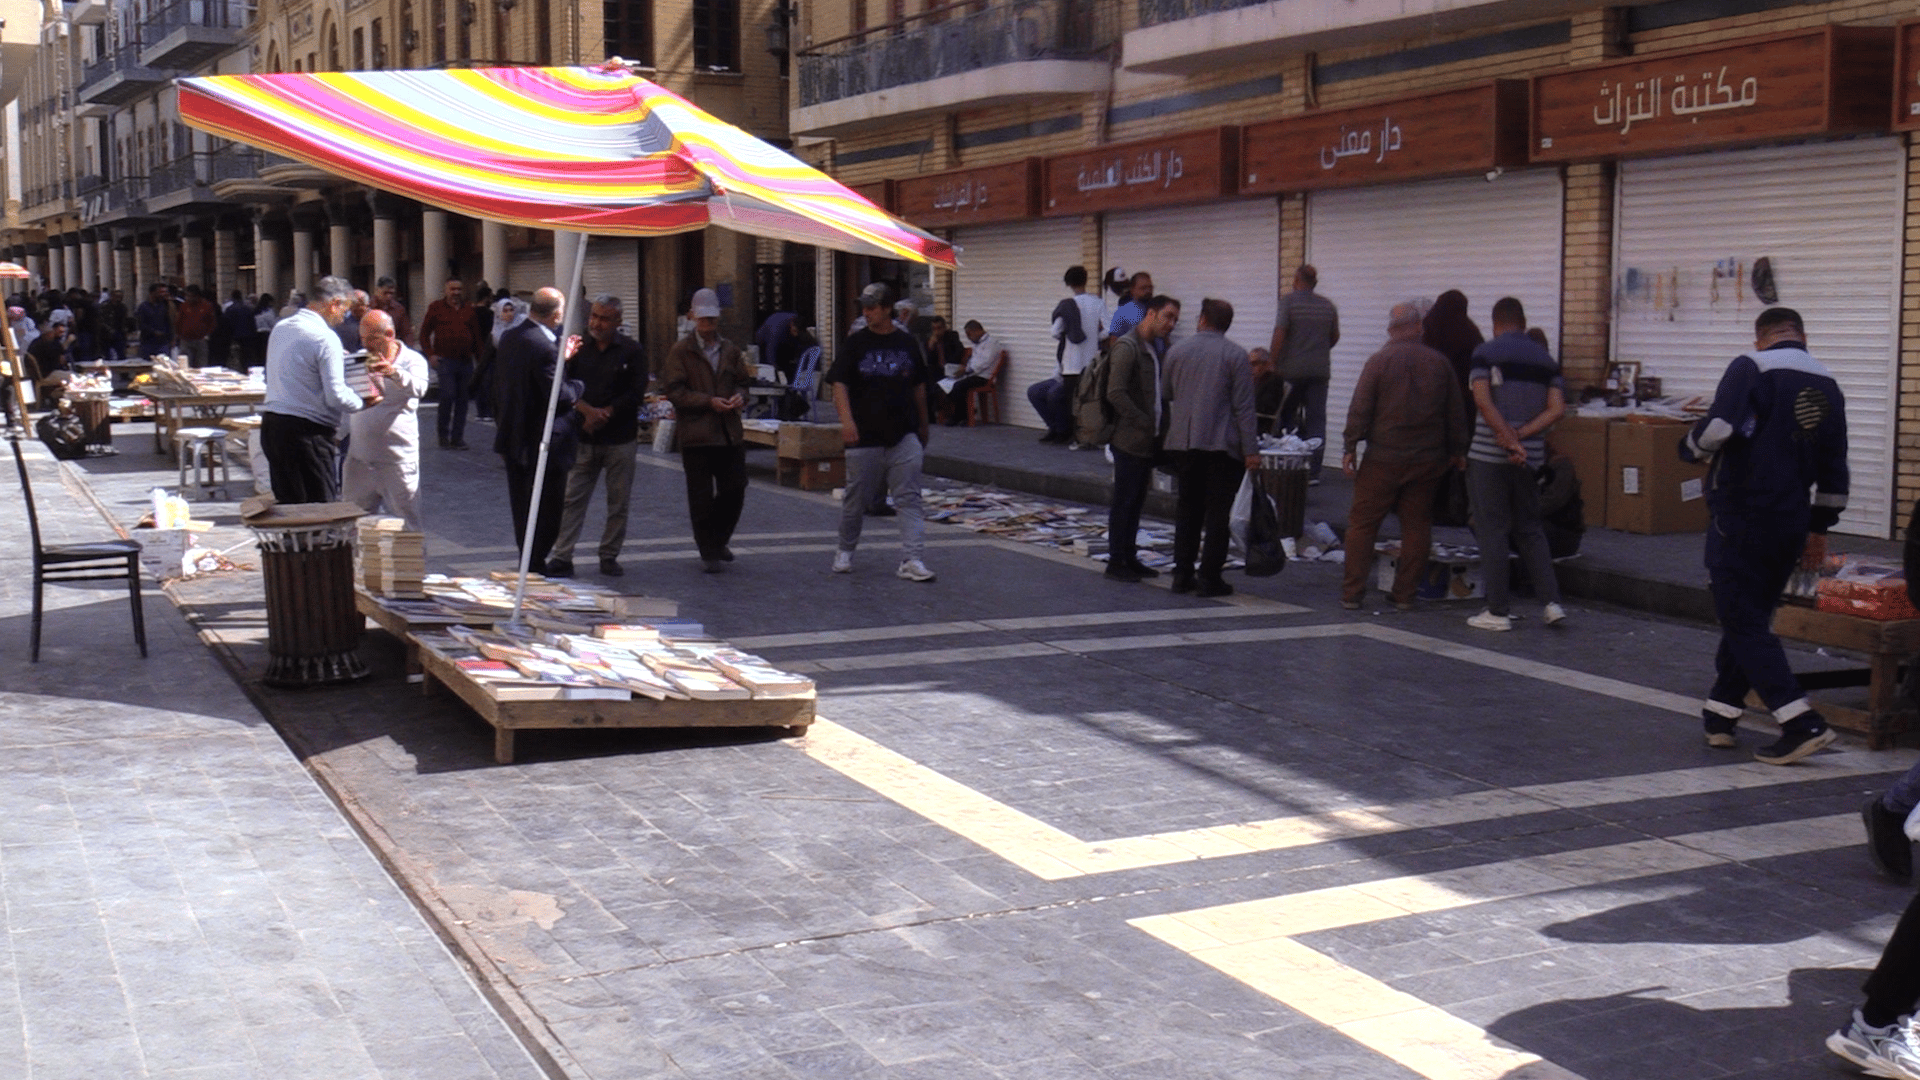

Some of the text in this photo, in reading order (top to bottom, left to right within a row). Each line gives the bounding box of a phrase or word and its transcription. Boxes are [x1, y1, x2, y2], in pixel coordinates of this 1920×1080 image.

[1594, 66, 1757, 135] مكتبة التراث
[1321, 117, 1401, 169] دار معنى
[973, 181, 987, 211] دار
[1078, 150, 1183, 197] دار الكتب العلمية
